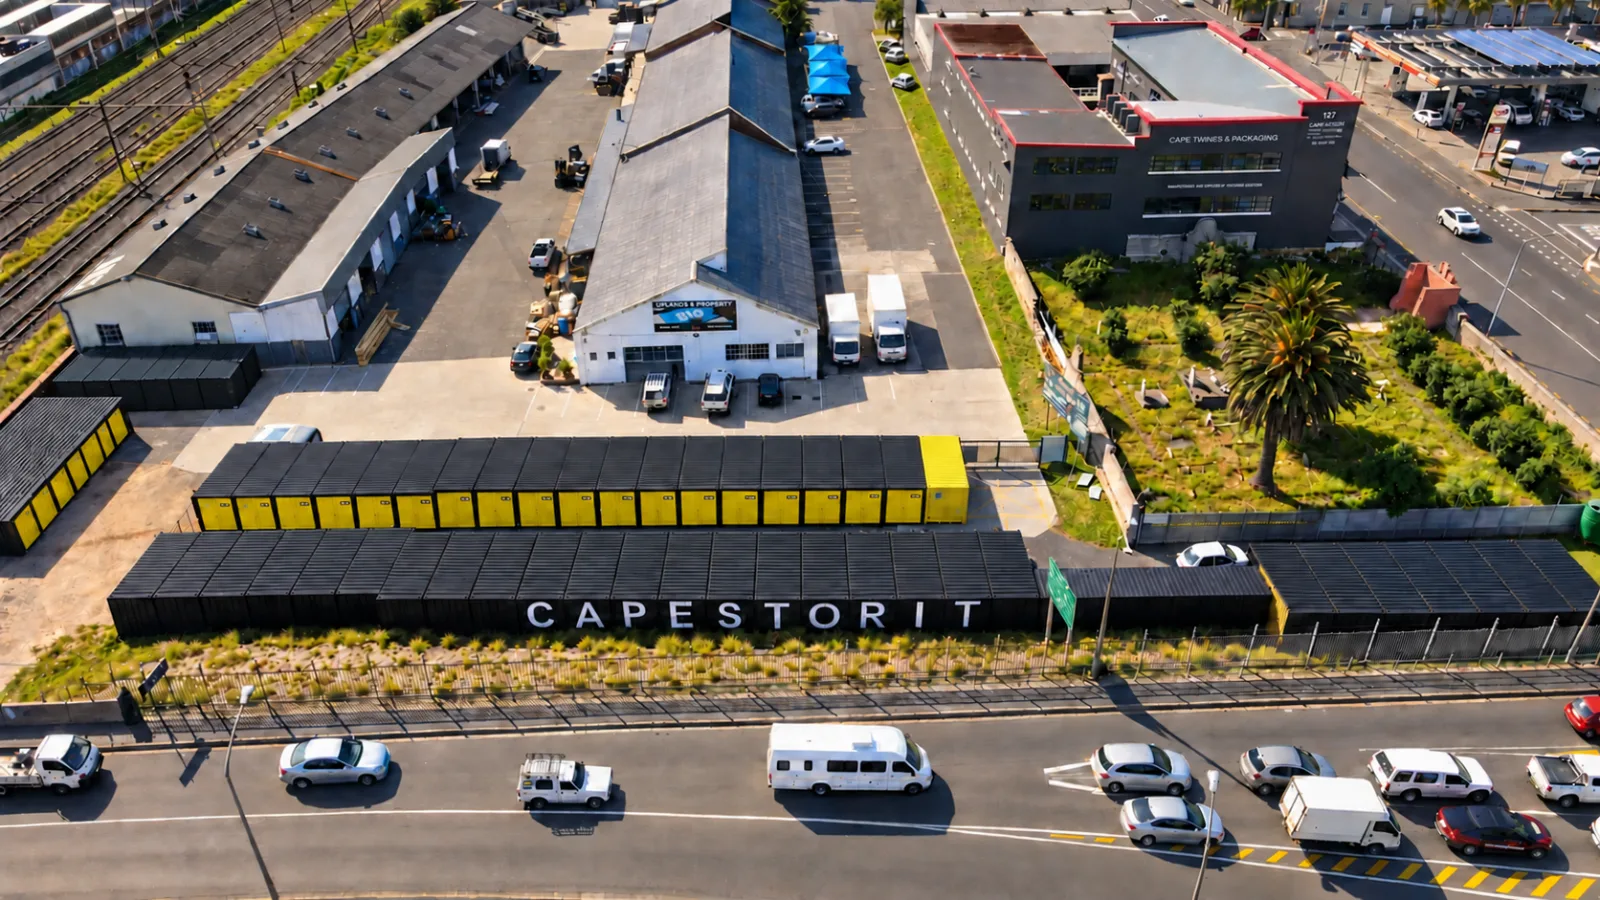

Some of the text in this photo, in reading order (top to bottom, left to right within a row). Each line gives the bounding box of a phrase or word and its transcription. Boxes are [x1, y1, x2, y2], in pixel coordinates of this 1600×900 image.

[1323, 111, 1337, 119] 127
[1168, 136, 1191, 144] CAPE
[1193, 135, 1223, 143] TWINES
[1231, 134, 1279, 142] PACKAGING
[526, 601, 981, 629] CAPESTORIT
